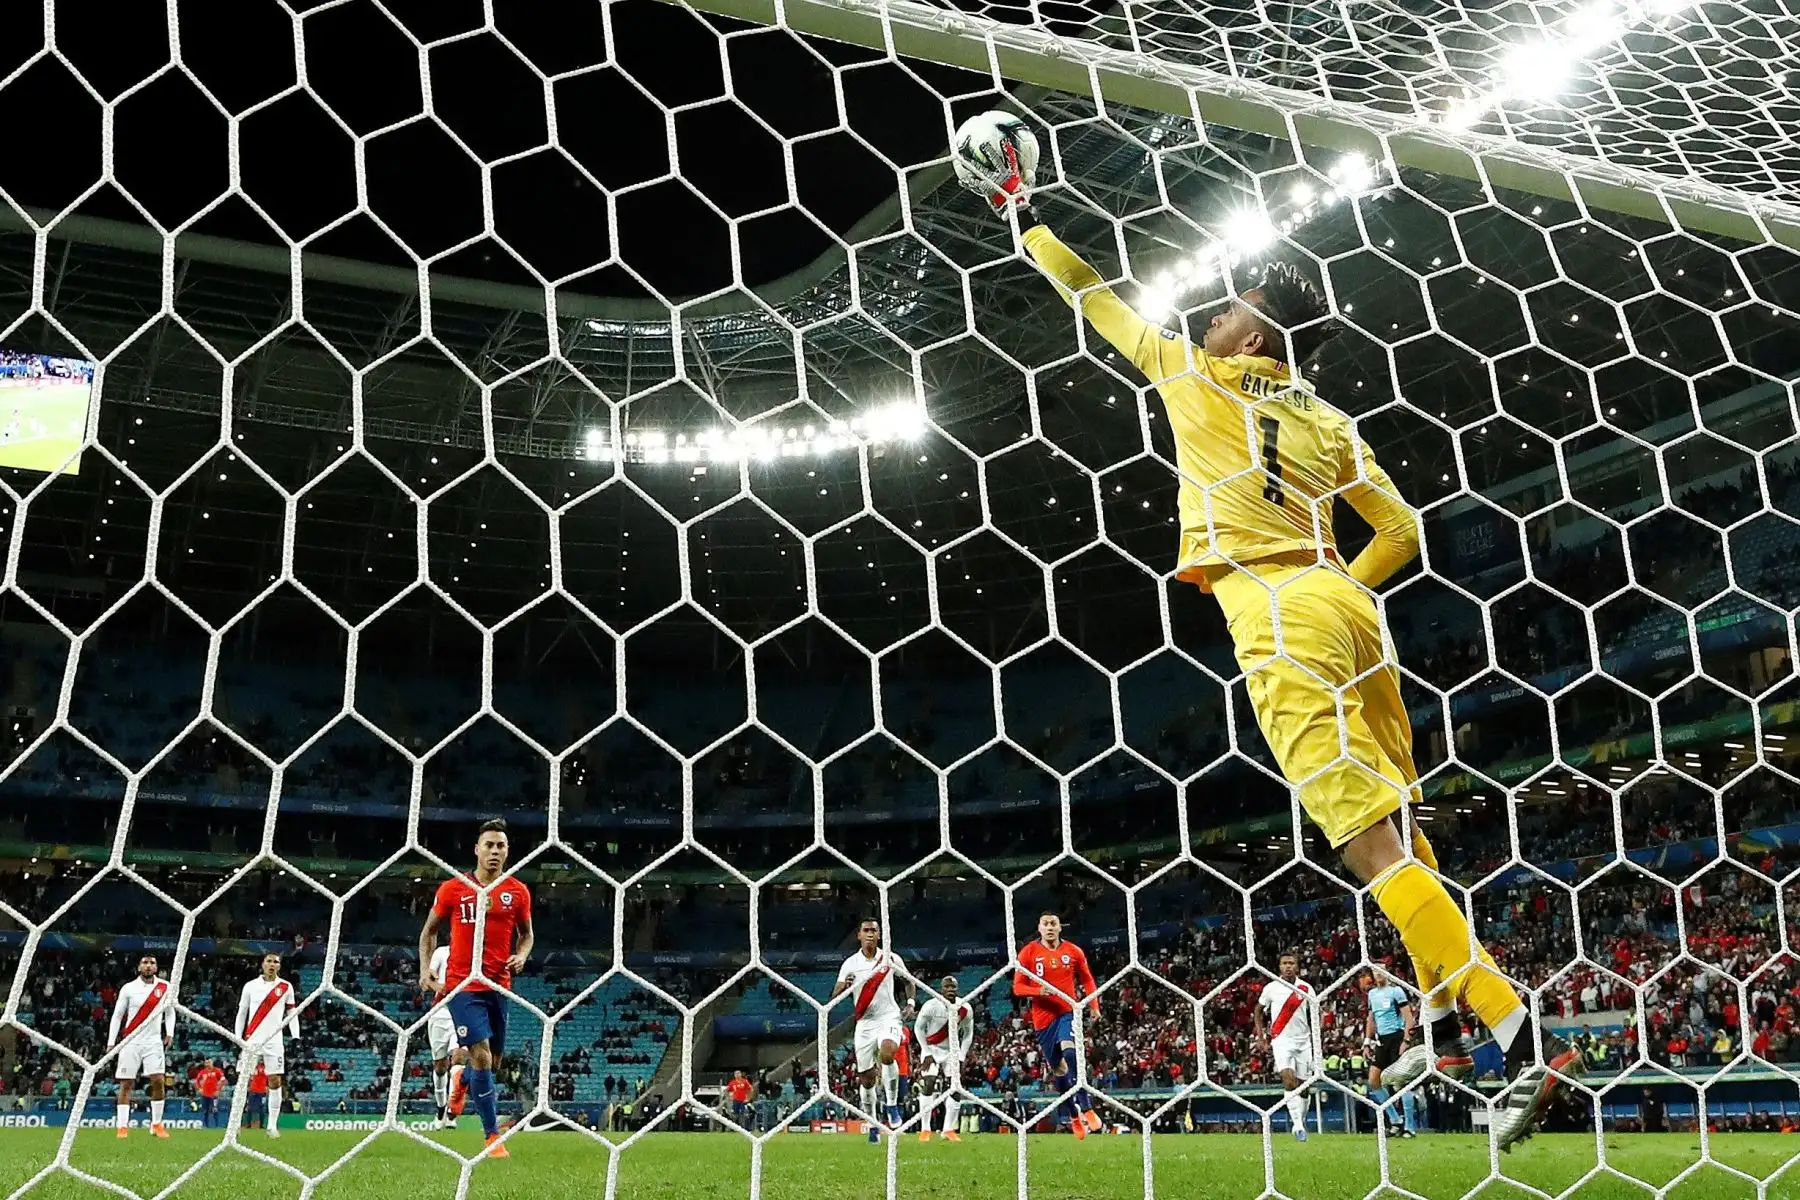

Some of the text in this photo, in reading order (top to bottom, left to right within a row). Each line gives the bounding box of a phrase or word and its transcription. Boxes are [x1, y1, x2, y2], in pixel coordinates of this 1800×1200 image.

[1240, 372, 1313, 412] GALLESE
[1260, 417, 1285, 507] 1
[459, 902, 477, 924] 11
[1035, 962, 1045, 978] 9
[142, 1118, 203, 1129] smpre
